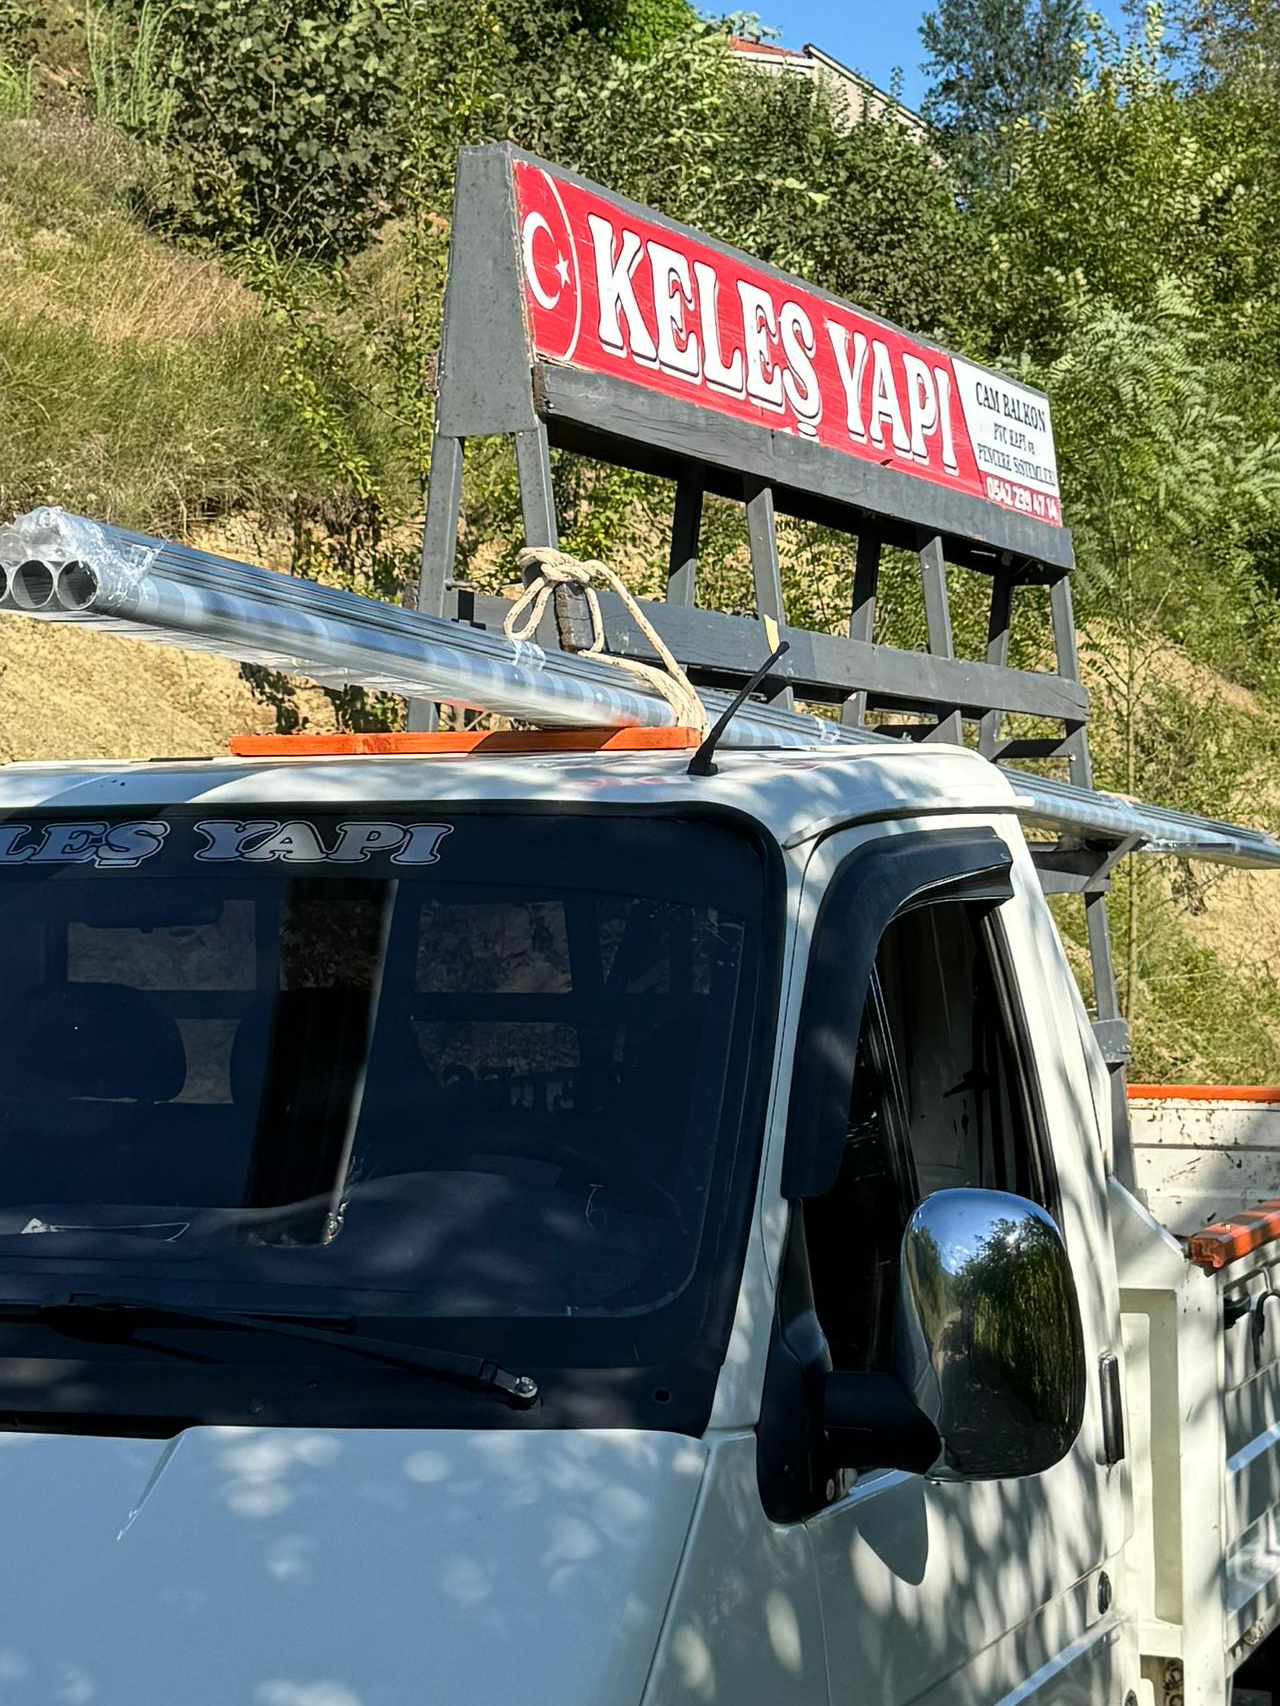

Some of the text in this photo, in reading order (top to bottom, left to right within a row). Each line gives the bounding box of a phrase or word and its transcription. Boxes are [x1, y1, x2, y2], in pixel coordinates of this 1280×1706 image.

[586, 212, 960, 477] KELEŞ YAPI
[975, 381, 1047, 433] CAM BALKON
[985, 476, 1058, 521] 0542 239 47 14
[192, 819, 456, 865] YAPI
